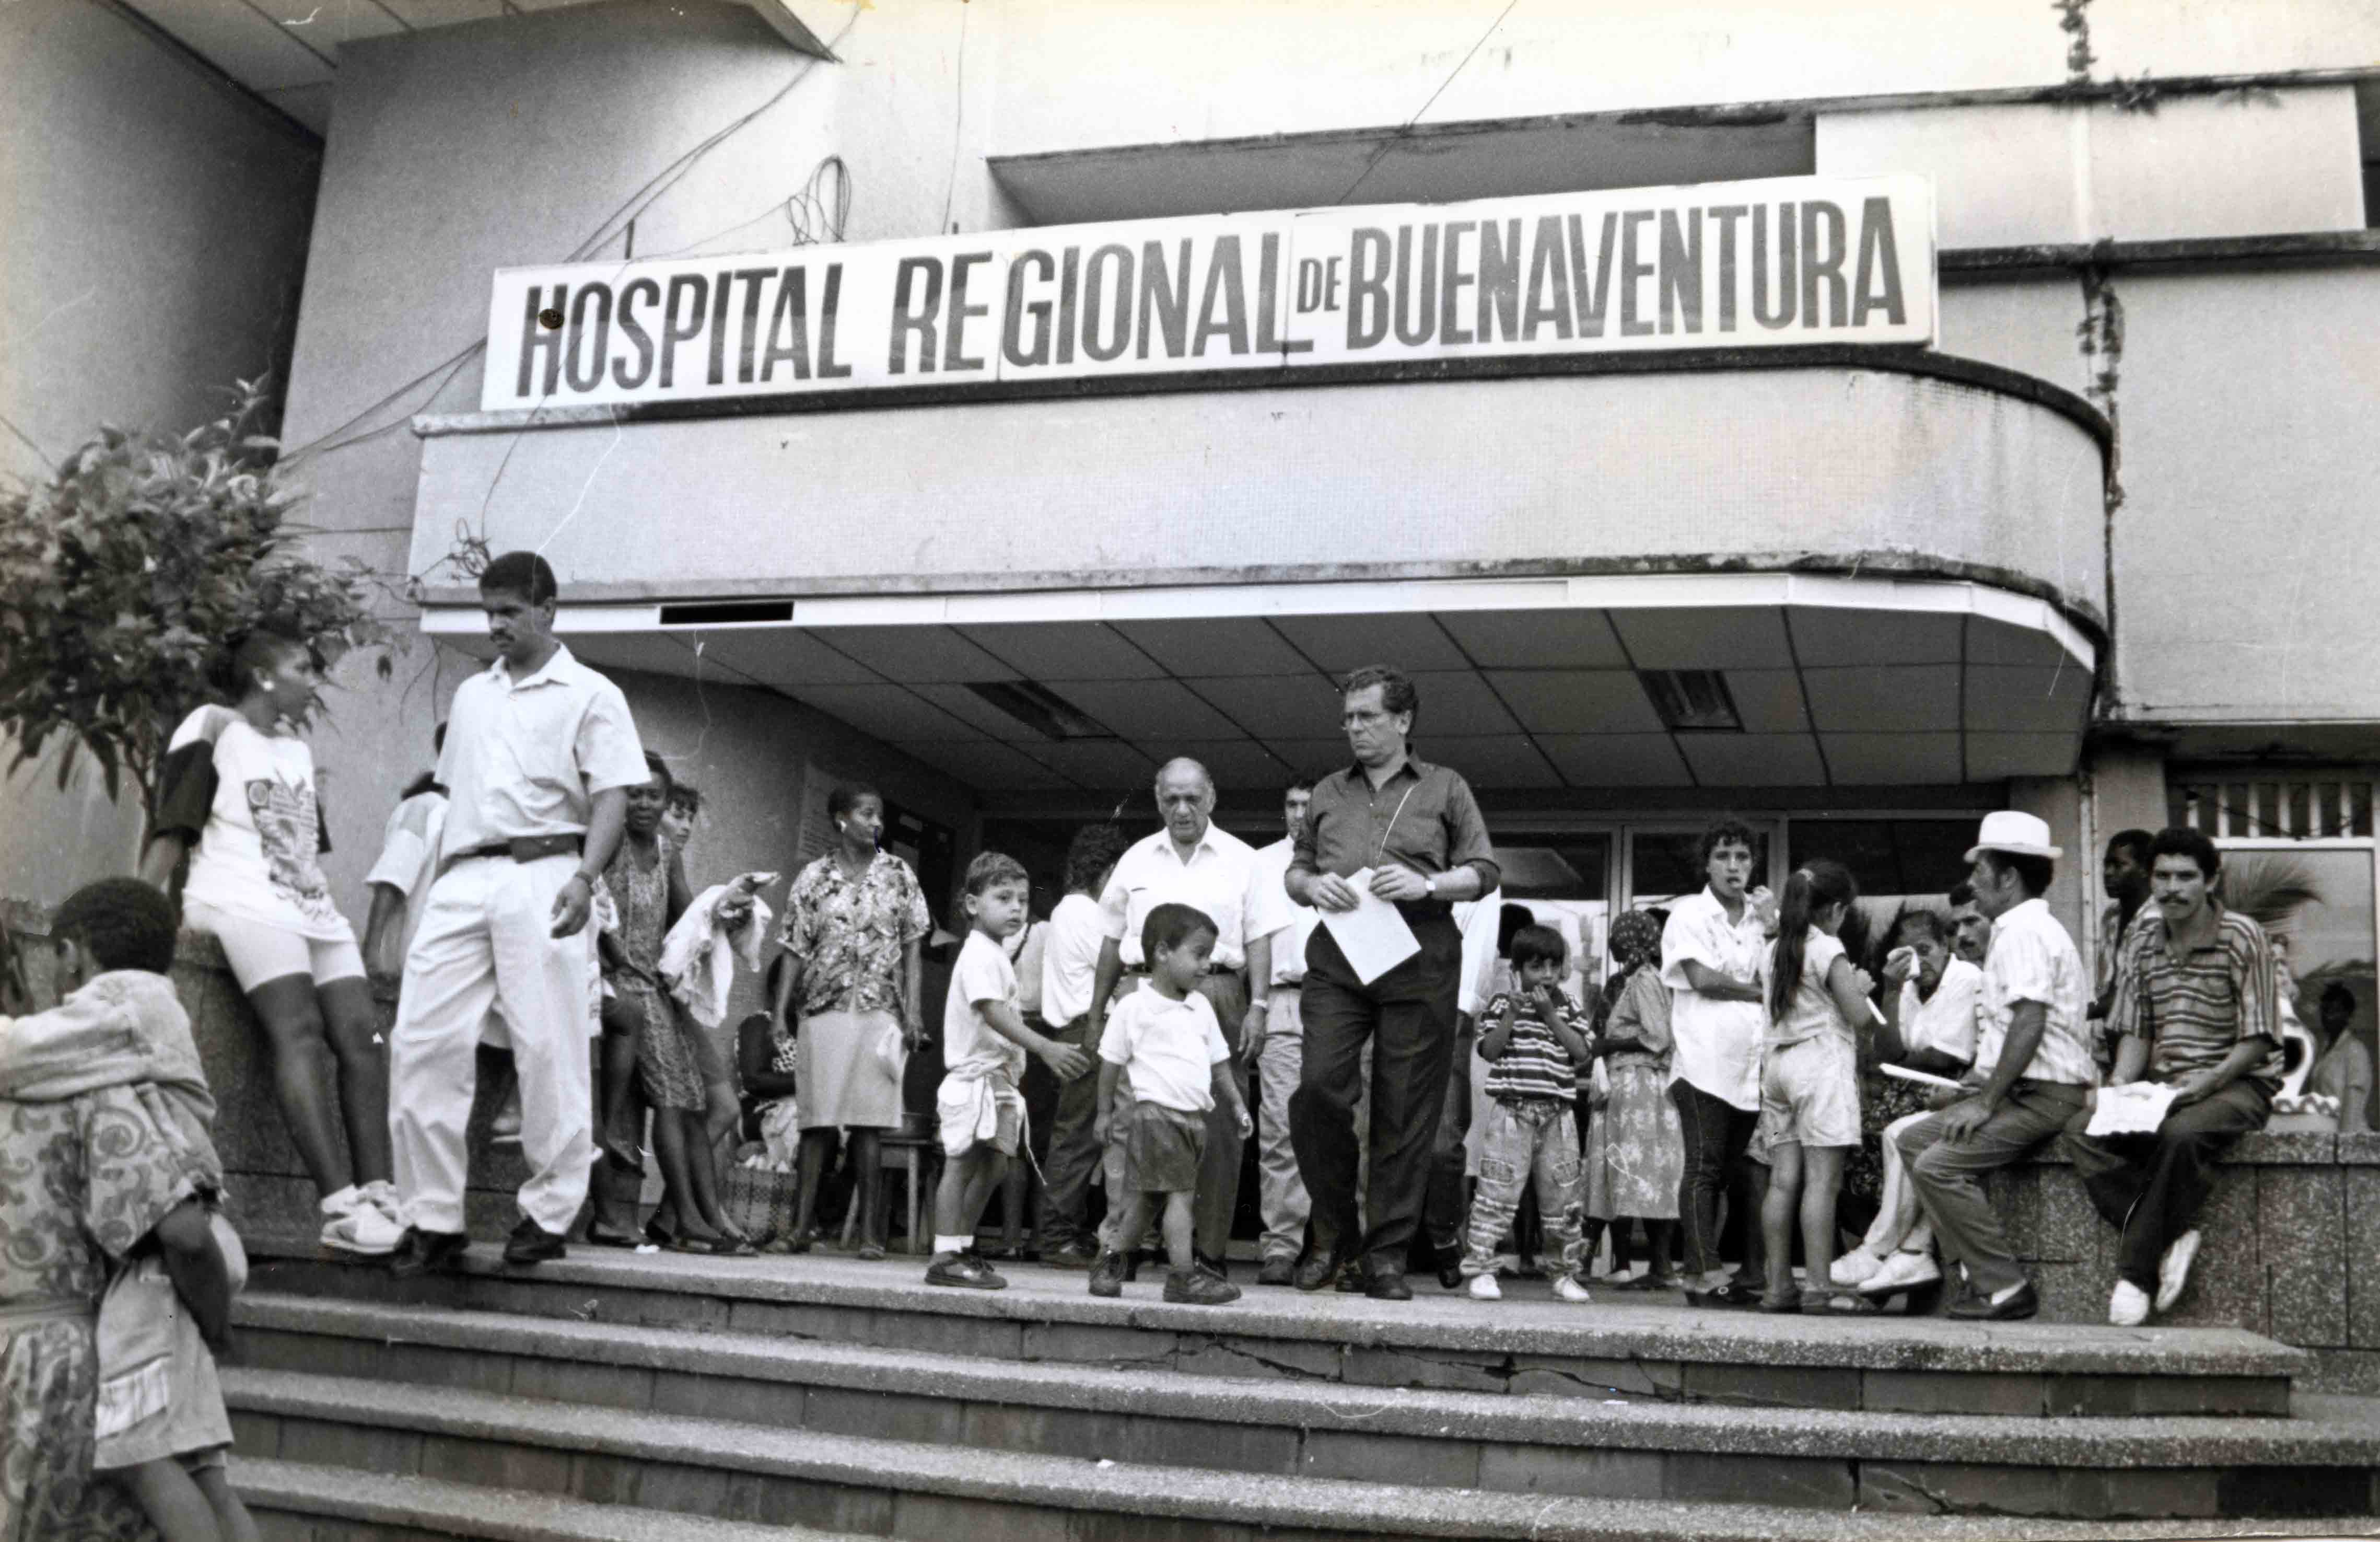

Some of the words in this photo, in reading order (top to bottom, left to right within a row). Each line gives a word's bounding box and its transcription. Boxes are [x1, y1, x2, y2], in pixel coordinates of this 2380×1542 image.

[517, 263, 851, 397] HOSPITAL
[888, 232, 1313, 375] REGIONAL
[1298, 256, 1343, 312] DE
[1347, 196, 1906, 350] BUENAVENTURA
